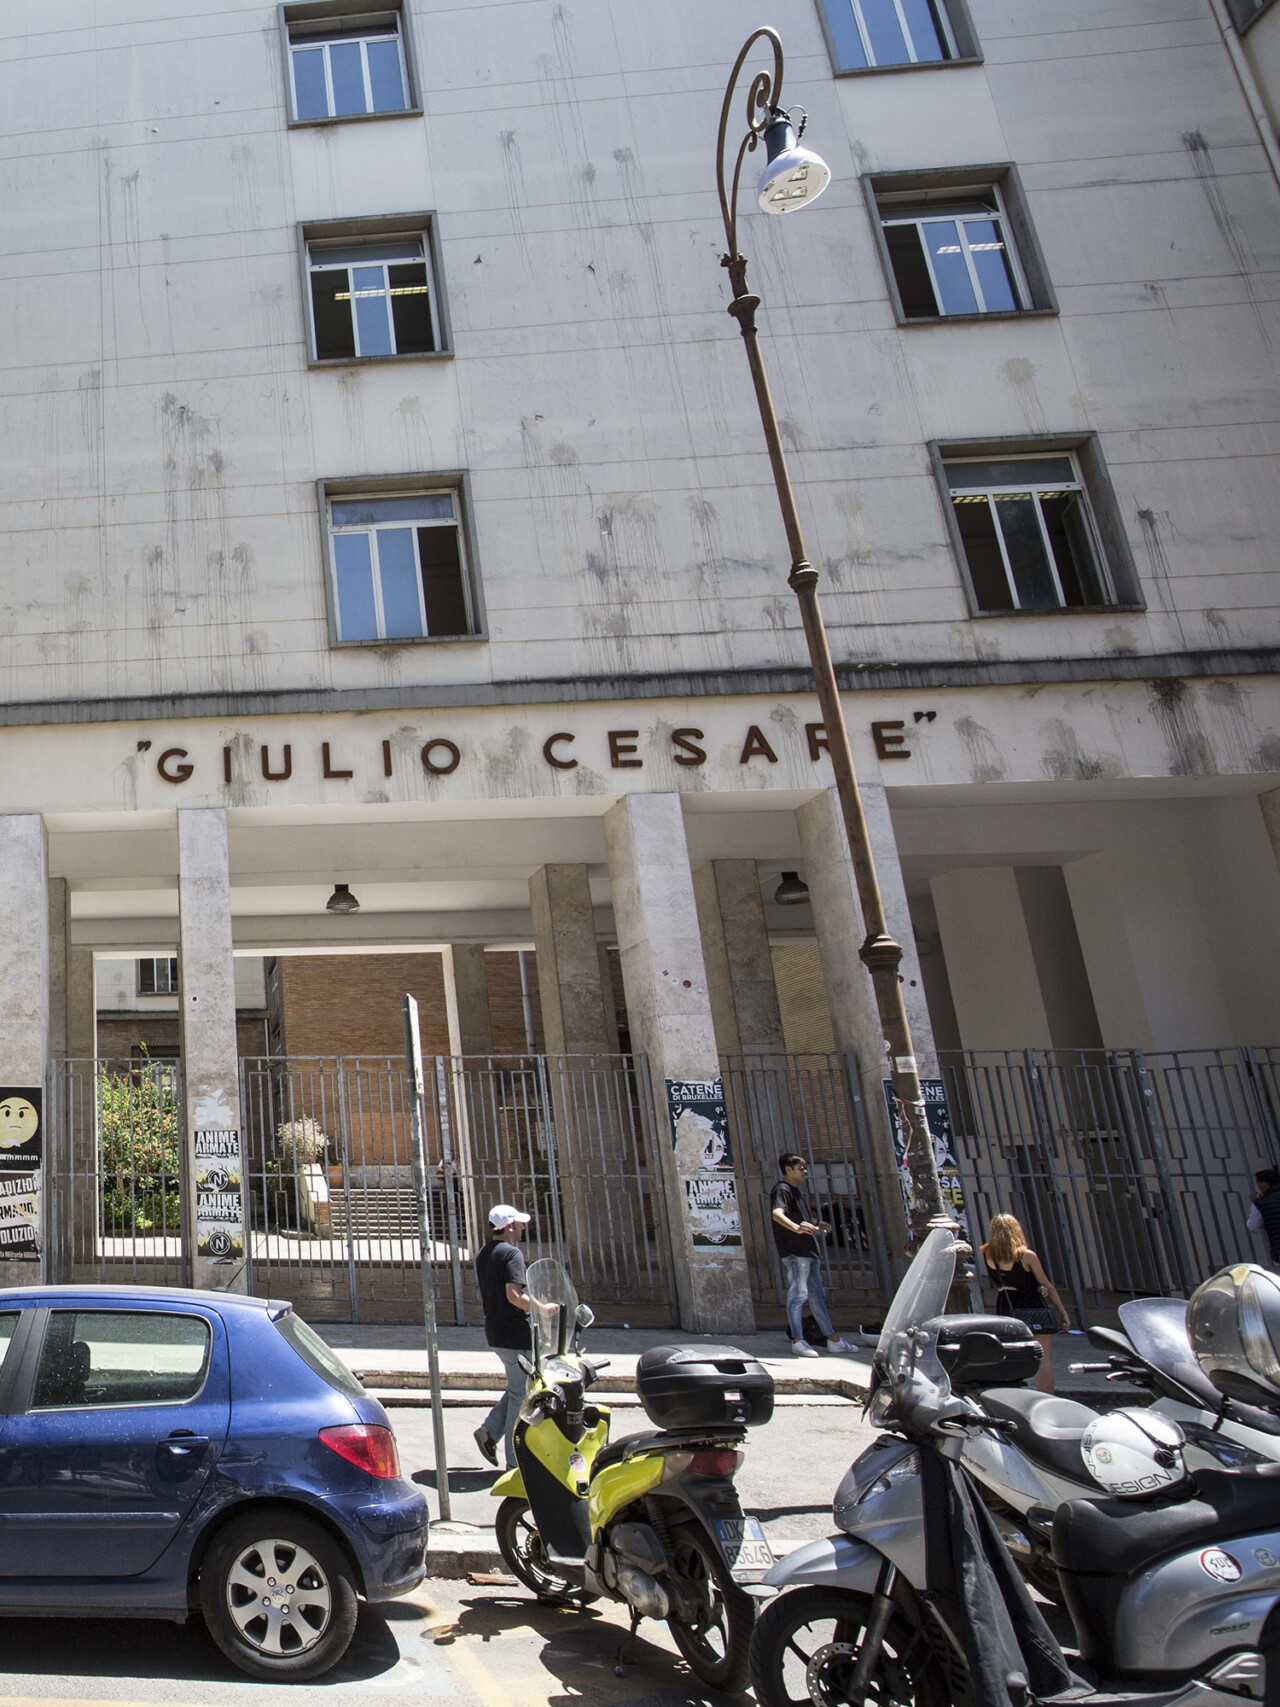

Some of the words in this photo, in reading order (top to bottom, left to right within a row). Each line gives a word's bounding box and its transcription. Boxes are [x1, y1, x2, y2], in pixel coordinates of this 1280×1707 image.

[671, 1085, 723, 1094] CATENE
[920, 1086, 944, 1096] ENE
[197, 1131, 236, 1143] ANIME
[195, 1142, 239, 1153] ARMATE
[200, 1194, 239, 1206] ANIME
[724, 1520, 745, 1539] DK
